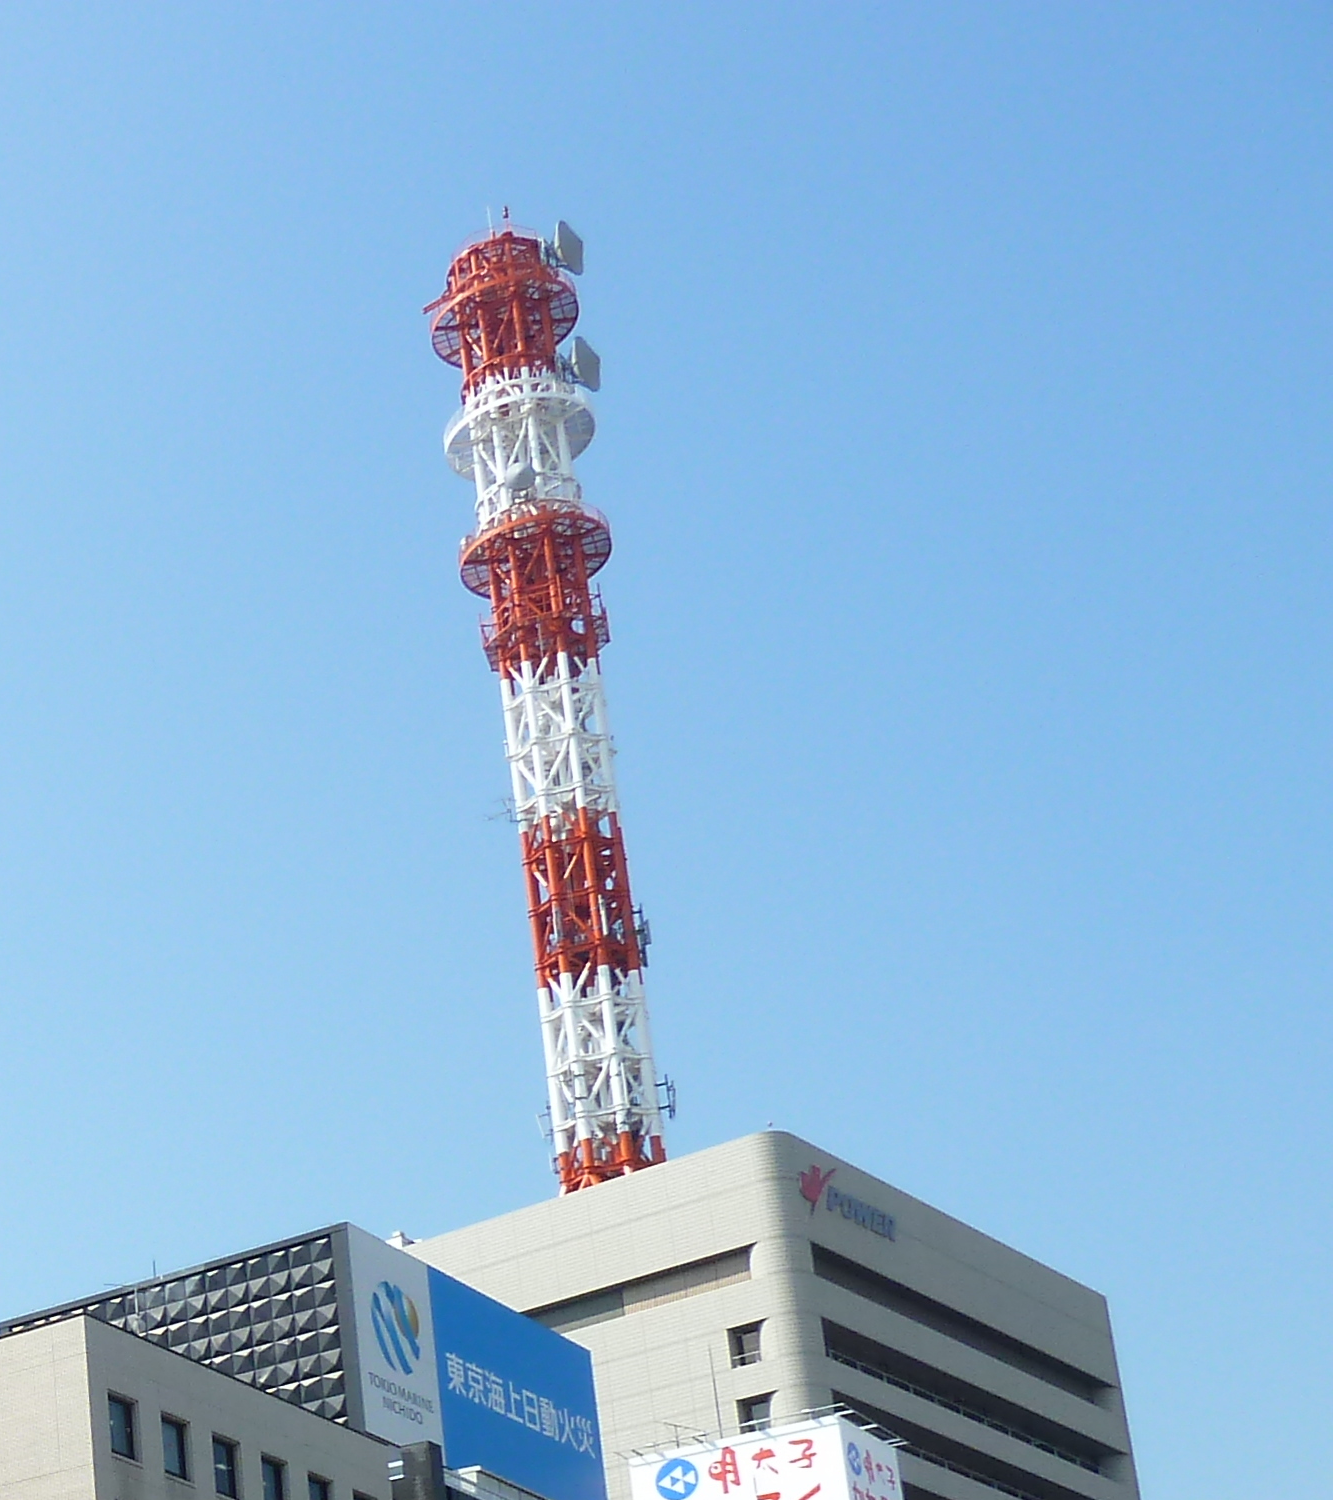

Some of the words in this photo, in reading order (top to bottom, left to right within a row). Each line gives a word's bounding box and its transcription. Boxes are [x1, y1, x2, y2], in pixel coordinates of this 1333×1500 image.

[826, 1185, 896, 1242] POWER
[367, 1371, 398, 1400] TOKIO
[445, 1351, 597, 1458] 東京海上日動火災
[708, 1438, 819, 1495] 明太子
